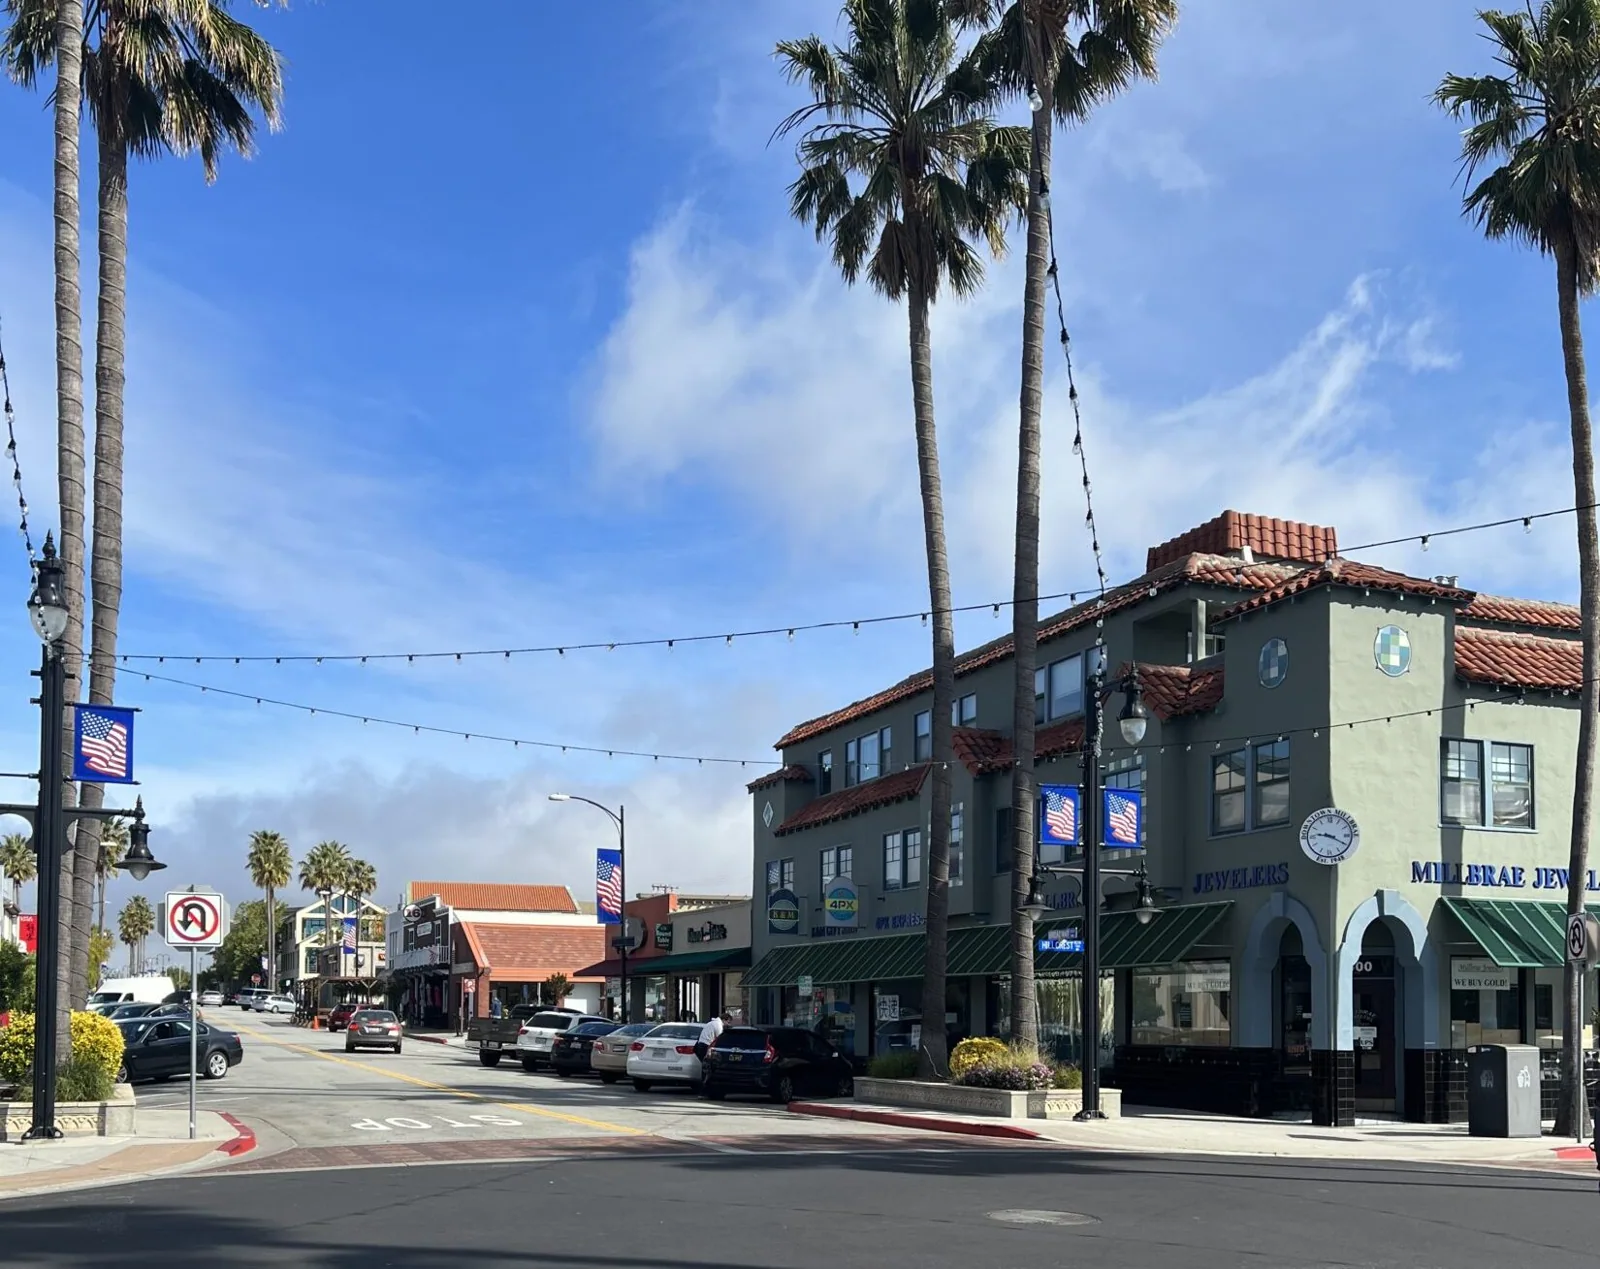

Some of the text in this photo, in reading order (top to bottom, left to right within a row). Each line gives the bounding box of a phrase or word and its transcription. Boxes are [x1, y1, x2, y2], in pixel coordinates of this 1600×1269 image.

[1301, 809, 1359, 840] DOWNTOWN MILLBRAE
[1193, 862, 1289, 894] JEWELERS
[1411, 861, 1600, 891] MILLBRAE JEWL
[829, 900, 855, 910] 4PX
[891, 912, 926, 929] EXPRESS
[1041, 940, 1074, 950] HILLCREST
[1354, 961, 1373, 972] 00
[1454, 978, 1508, 987] WE BUY GOLD!
[351, 1114, 524, 1131] STOP
